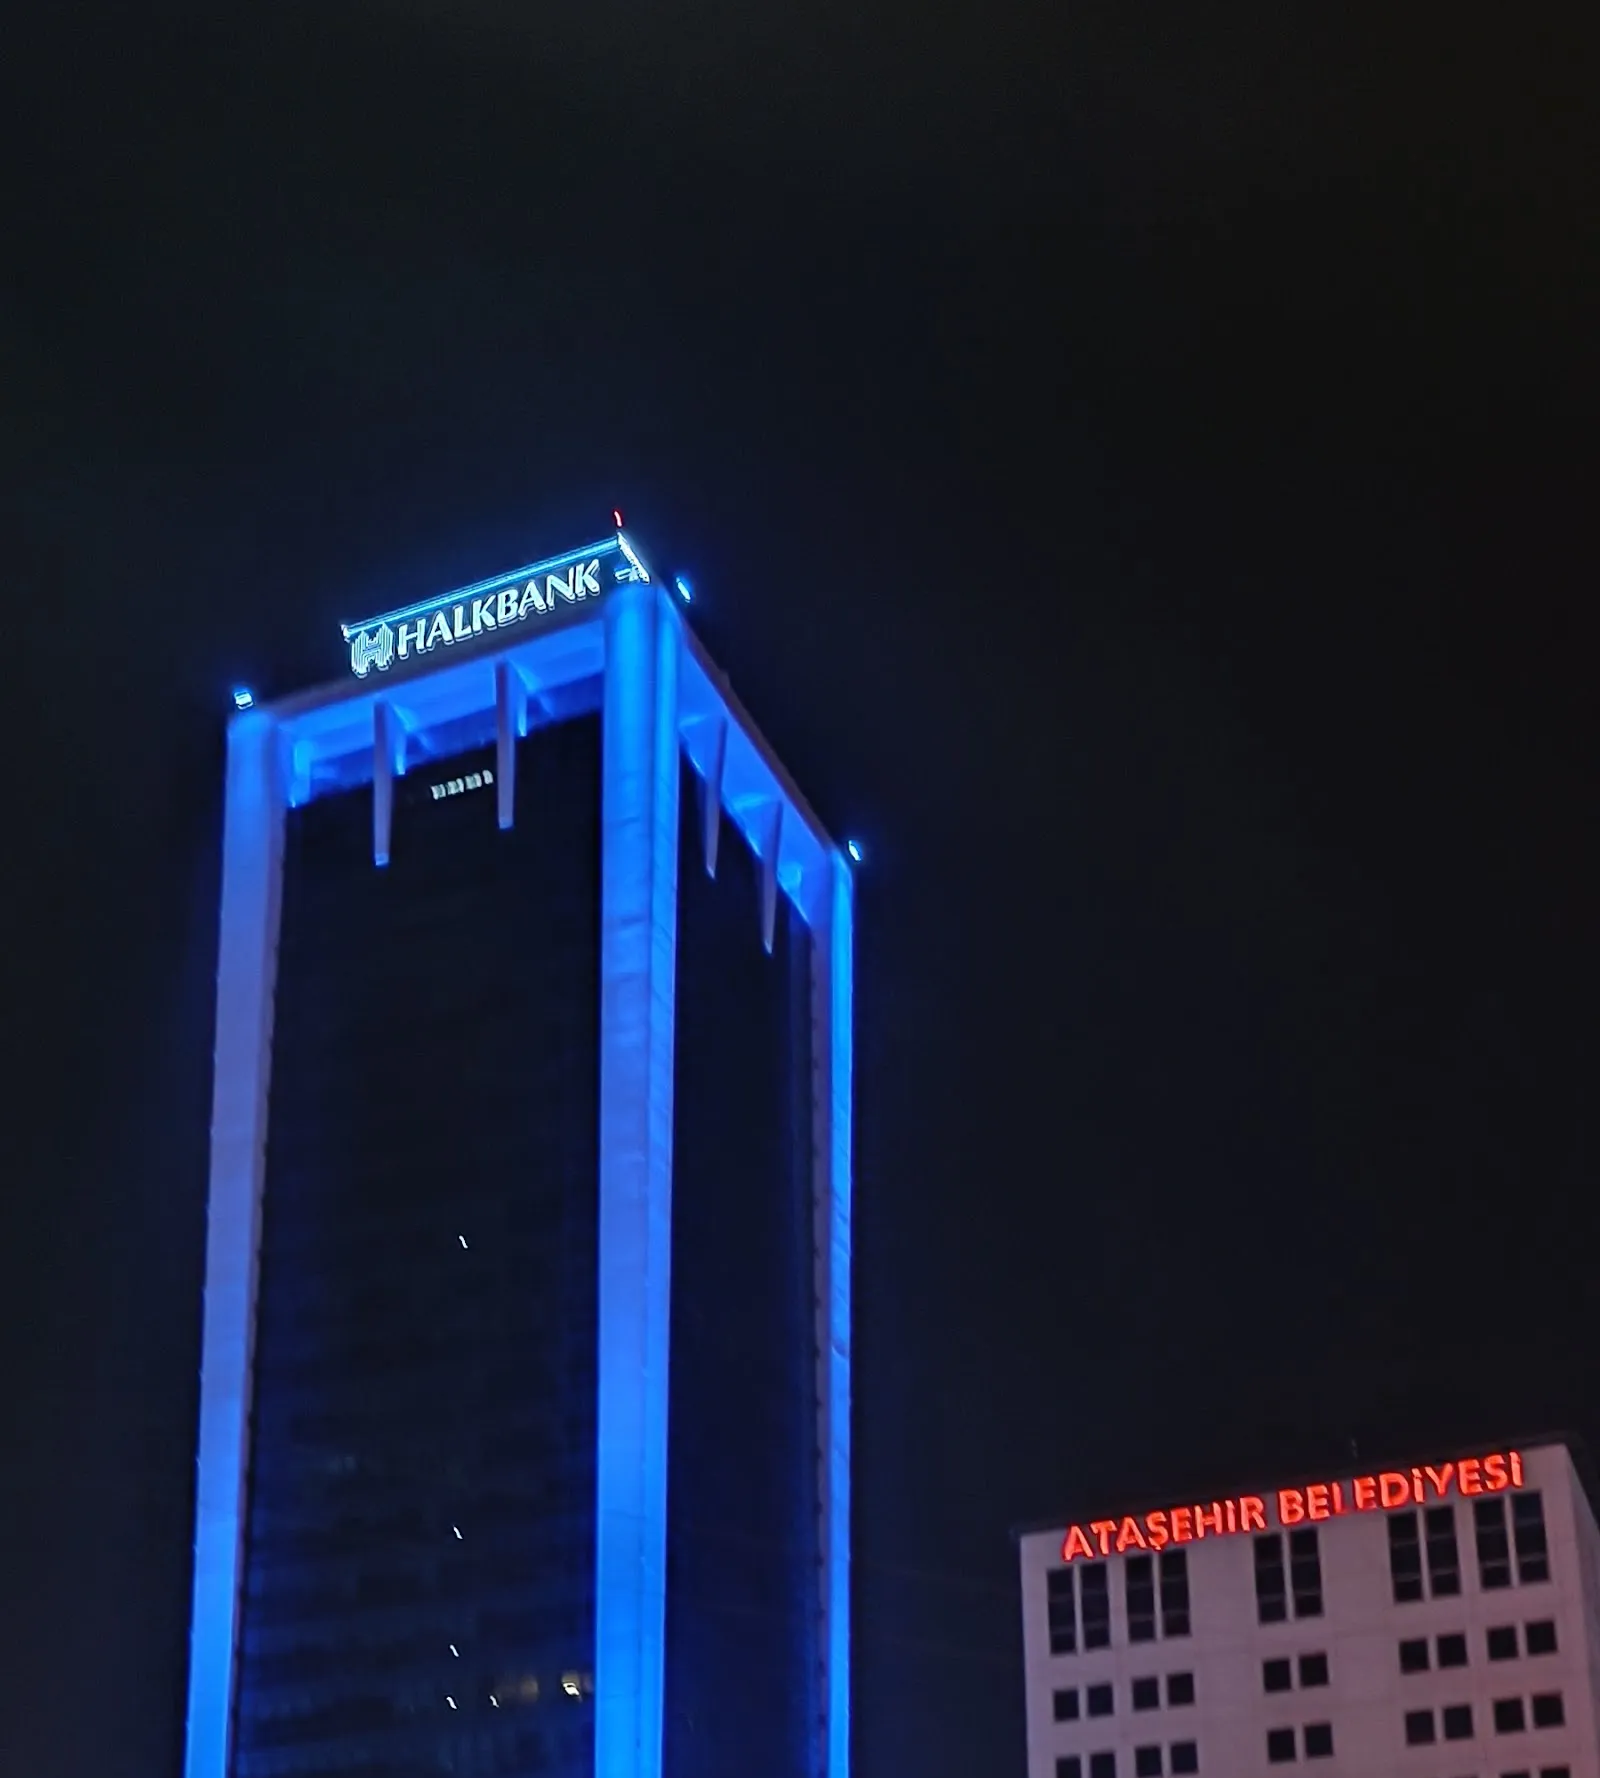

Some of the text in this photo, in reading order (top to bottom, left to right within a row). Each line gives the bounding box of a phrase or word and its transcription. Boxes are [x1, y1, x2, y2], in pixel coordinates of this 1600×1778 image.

[397, 558, 601, 660] HALKBANK
[1062, 1451, 1524, 1562] ATAŞEHİR BELEDİYESİ
